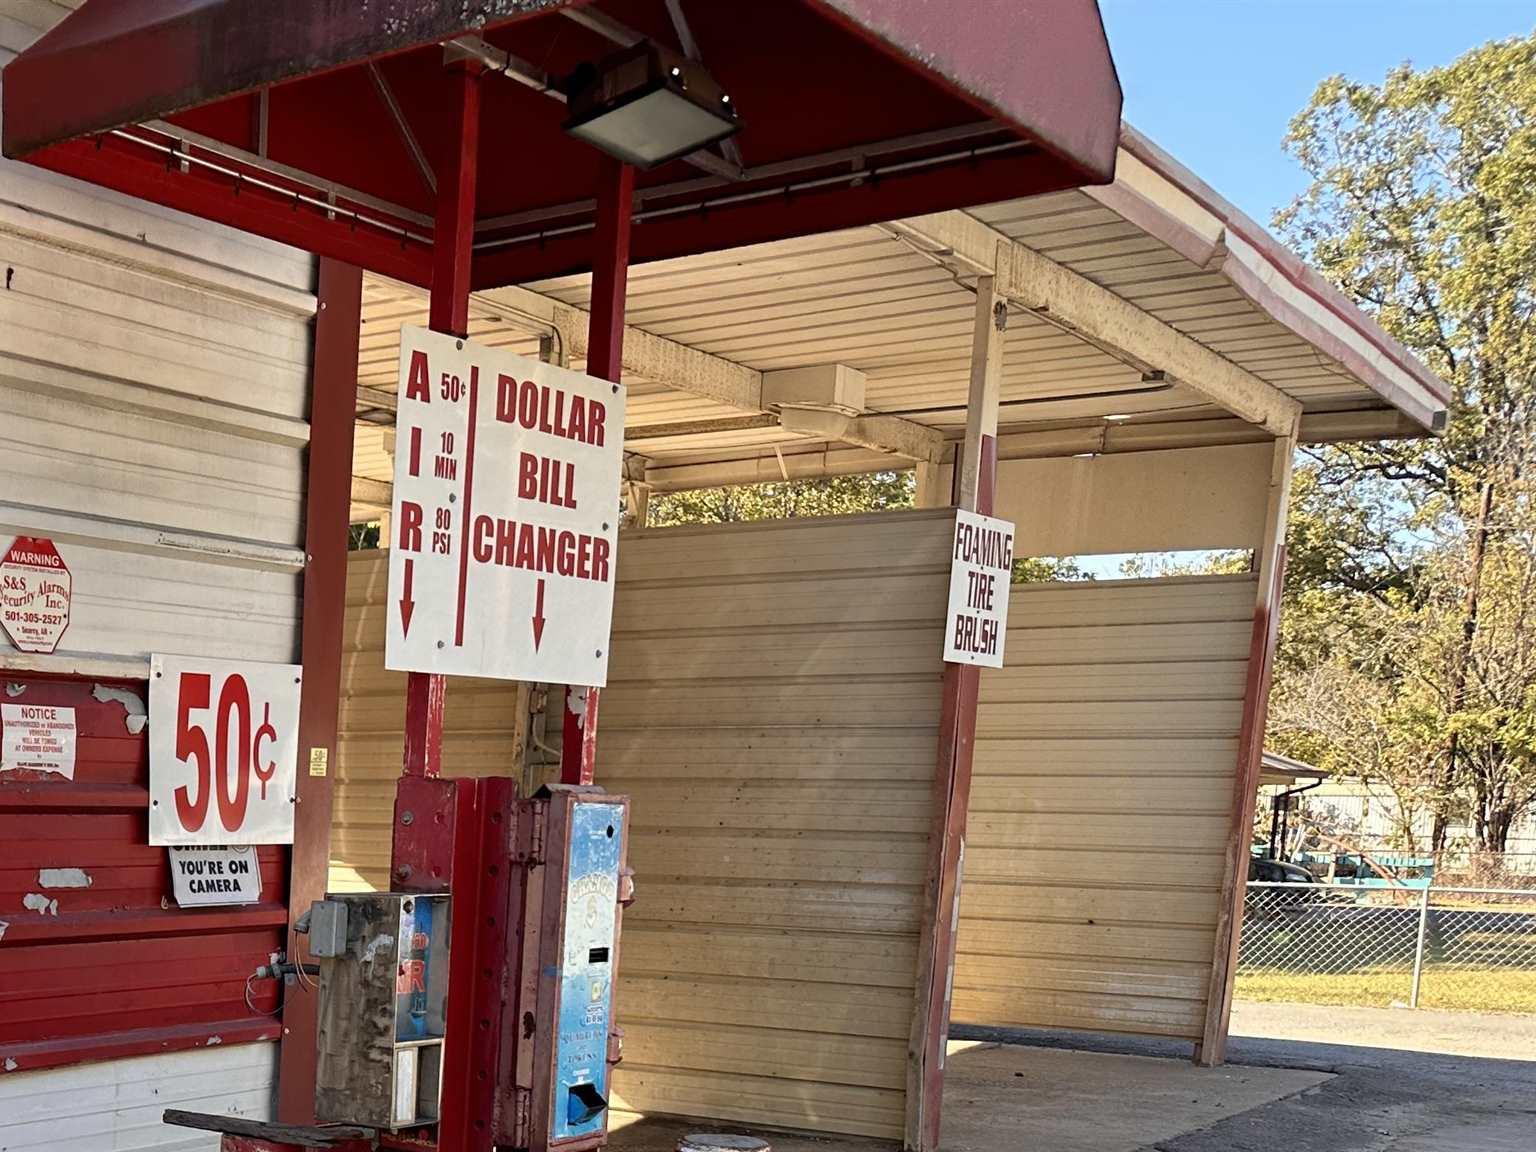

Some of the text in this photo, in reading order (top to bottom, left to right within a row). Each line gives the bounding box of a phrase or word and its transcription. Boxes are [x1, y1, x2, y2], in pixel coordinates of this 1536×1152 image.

[440, 373, 466, 403] 50¢
[495, 373, 607, 448] DOLLAR
[399, 350, 431, 554] AIR
[440, 432, 454, 455] 10
[434, 455, 457, 481] MIN
[517, 451, 577, 509] BILL
[436, 508, 451, 531] 80
[432, 531, 451, 555] PSI
[472, 514, 611, 582] CHANGER
[954, 522, 1013, 572] FOAMING
[10, 550, 60, 567] WARNING
[3, 575, 26, 591] S&S
[37, 580, 69, 602] Alarms
[966, 571, 995, 611] TIRE
[45, 595, 65, 609] Inc.
[5, 610, 62, 625] 501-305-2527
[953, 614, 999, 656] BRUSH
[21, 708, 57, 720] NOTICE
[174, 671, 277, 833] 50¢
[179, 860, 249, 875] YOU'RE ON
[189, 878, 242, 894] CAMERA
